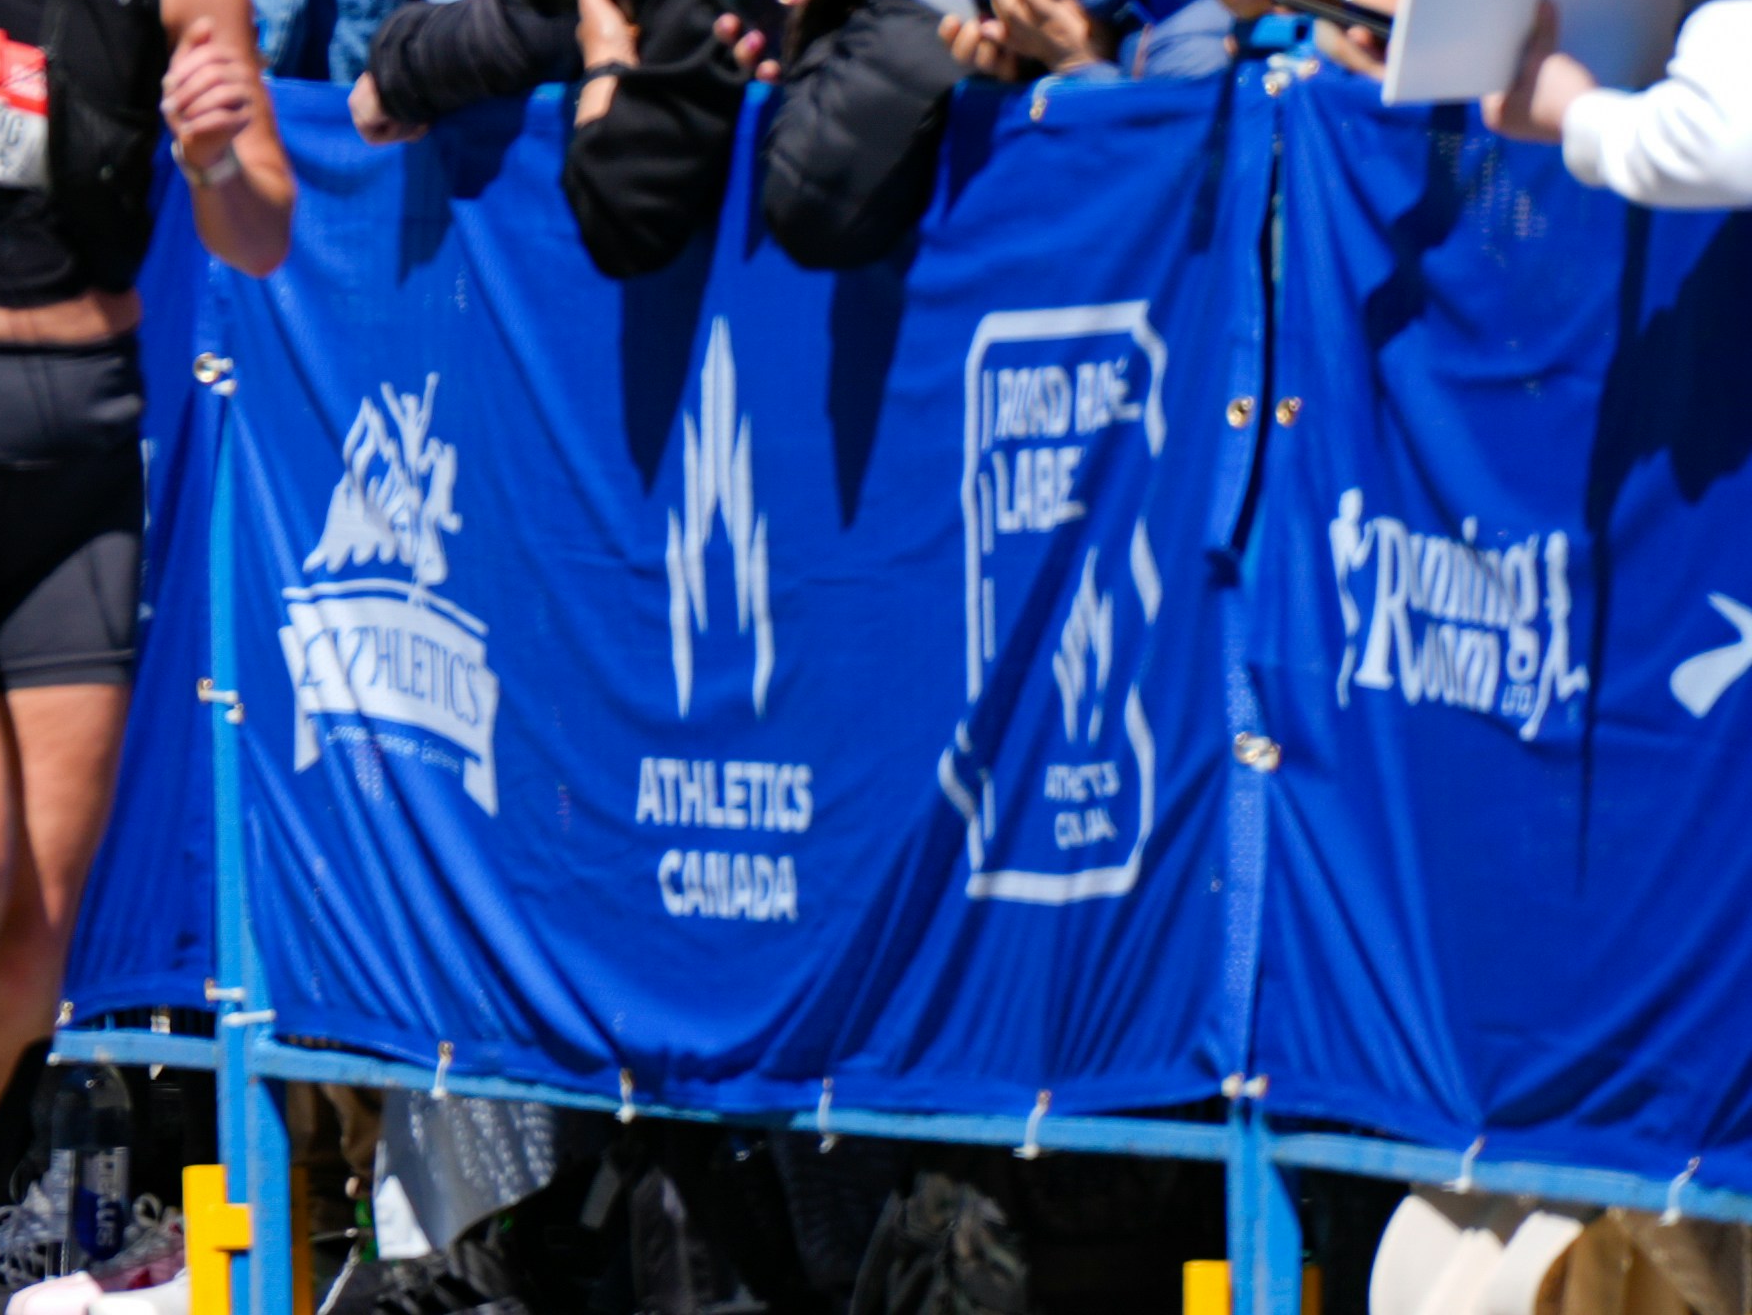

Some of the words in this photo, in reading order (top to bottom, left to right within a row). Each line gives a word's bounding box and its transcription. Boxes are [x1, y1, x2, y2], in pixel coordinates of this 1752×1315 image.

[991, 444, 1087, 535] LABE
[635, 756, 814, 834] ATHLETICS
[657, 848, 799, 922] CANADA
